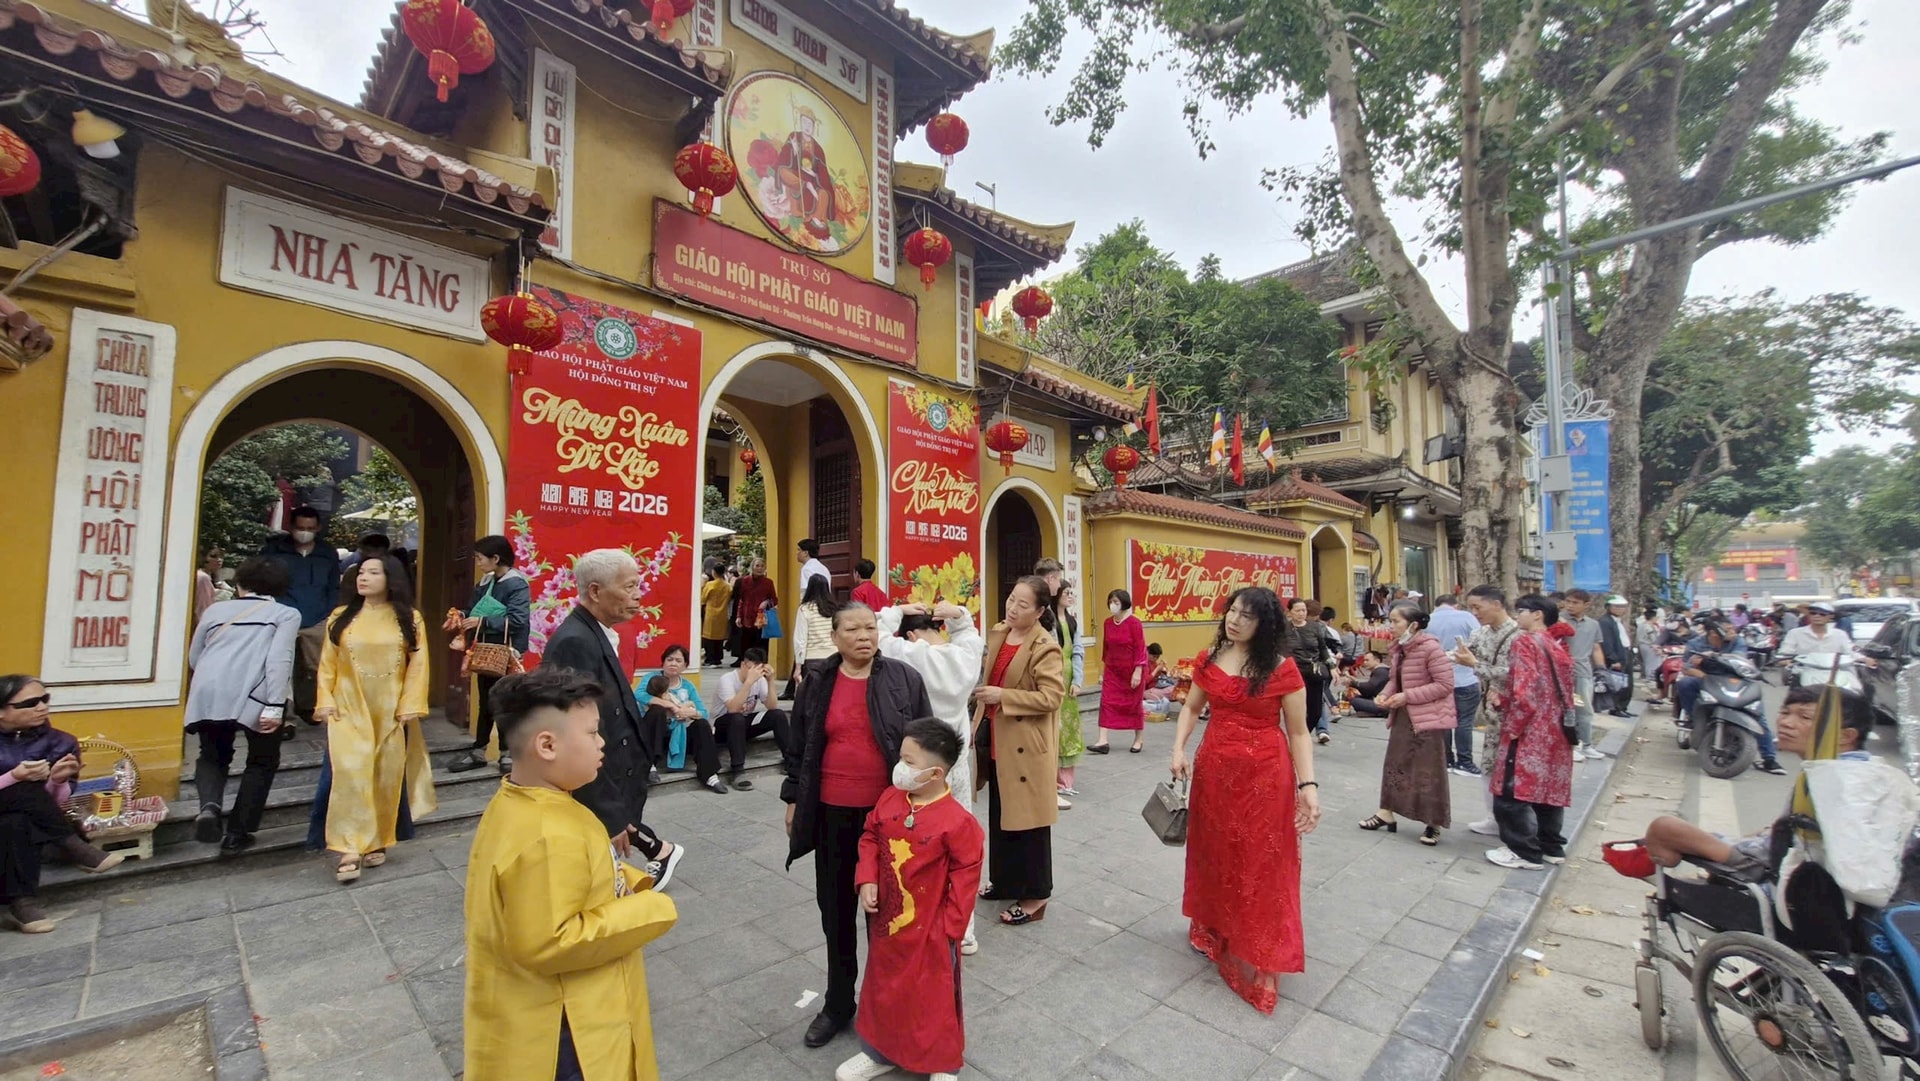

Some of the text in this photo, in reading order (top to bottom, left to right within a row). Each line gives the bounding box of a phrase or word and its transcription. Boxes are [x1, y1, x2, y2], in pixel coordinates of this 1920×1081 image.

[269, 224, 460, 312] NHÀ TĂNG
[780, 256, 831, 285] TRỤ SỞ
[675, 244, 905, 340] GIÁO HỘI PHẬT GIÁO VIỆT NAM
[98, 334, 149, 378] CHÙA
[562, 353, 582, 366] HỘI
[585, 359, 614, 373] PHẬT
[616, 365, 641, 379] GIÁO
[643, 371, 666, 384] VIỆT
[667, 378, 688, 389] NAM
[94, 382, 147, 418] TRUNG
[568, 367, 657, 396] HỘI ĐỒNG TRỊ SỰ
[522, 387, 689, 449] Mừng Xuân
[897, 425, 911, 435] GIÁO
[938, 436, 951, 444] GIÁO
[88, 425, 142, 464] ƯƠNG
[556, 435, 660, 490] Di Lặc
[892, 460, 979, 499] Chúc Mừng
[540, 504, 569, 513] HAPPY
[618, 491, 668, 516] 2026
[80, 517, 137, 561] PHẬT
[942, 524, 967, 541] 2026
[77, 559, 133, 602] MỞ
[73, 616, 130, 649] MANG
